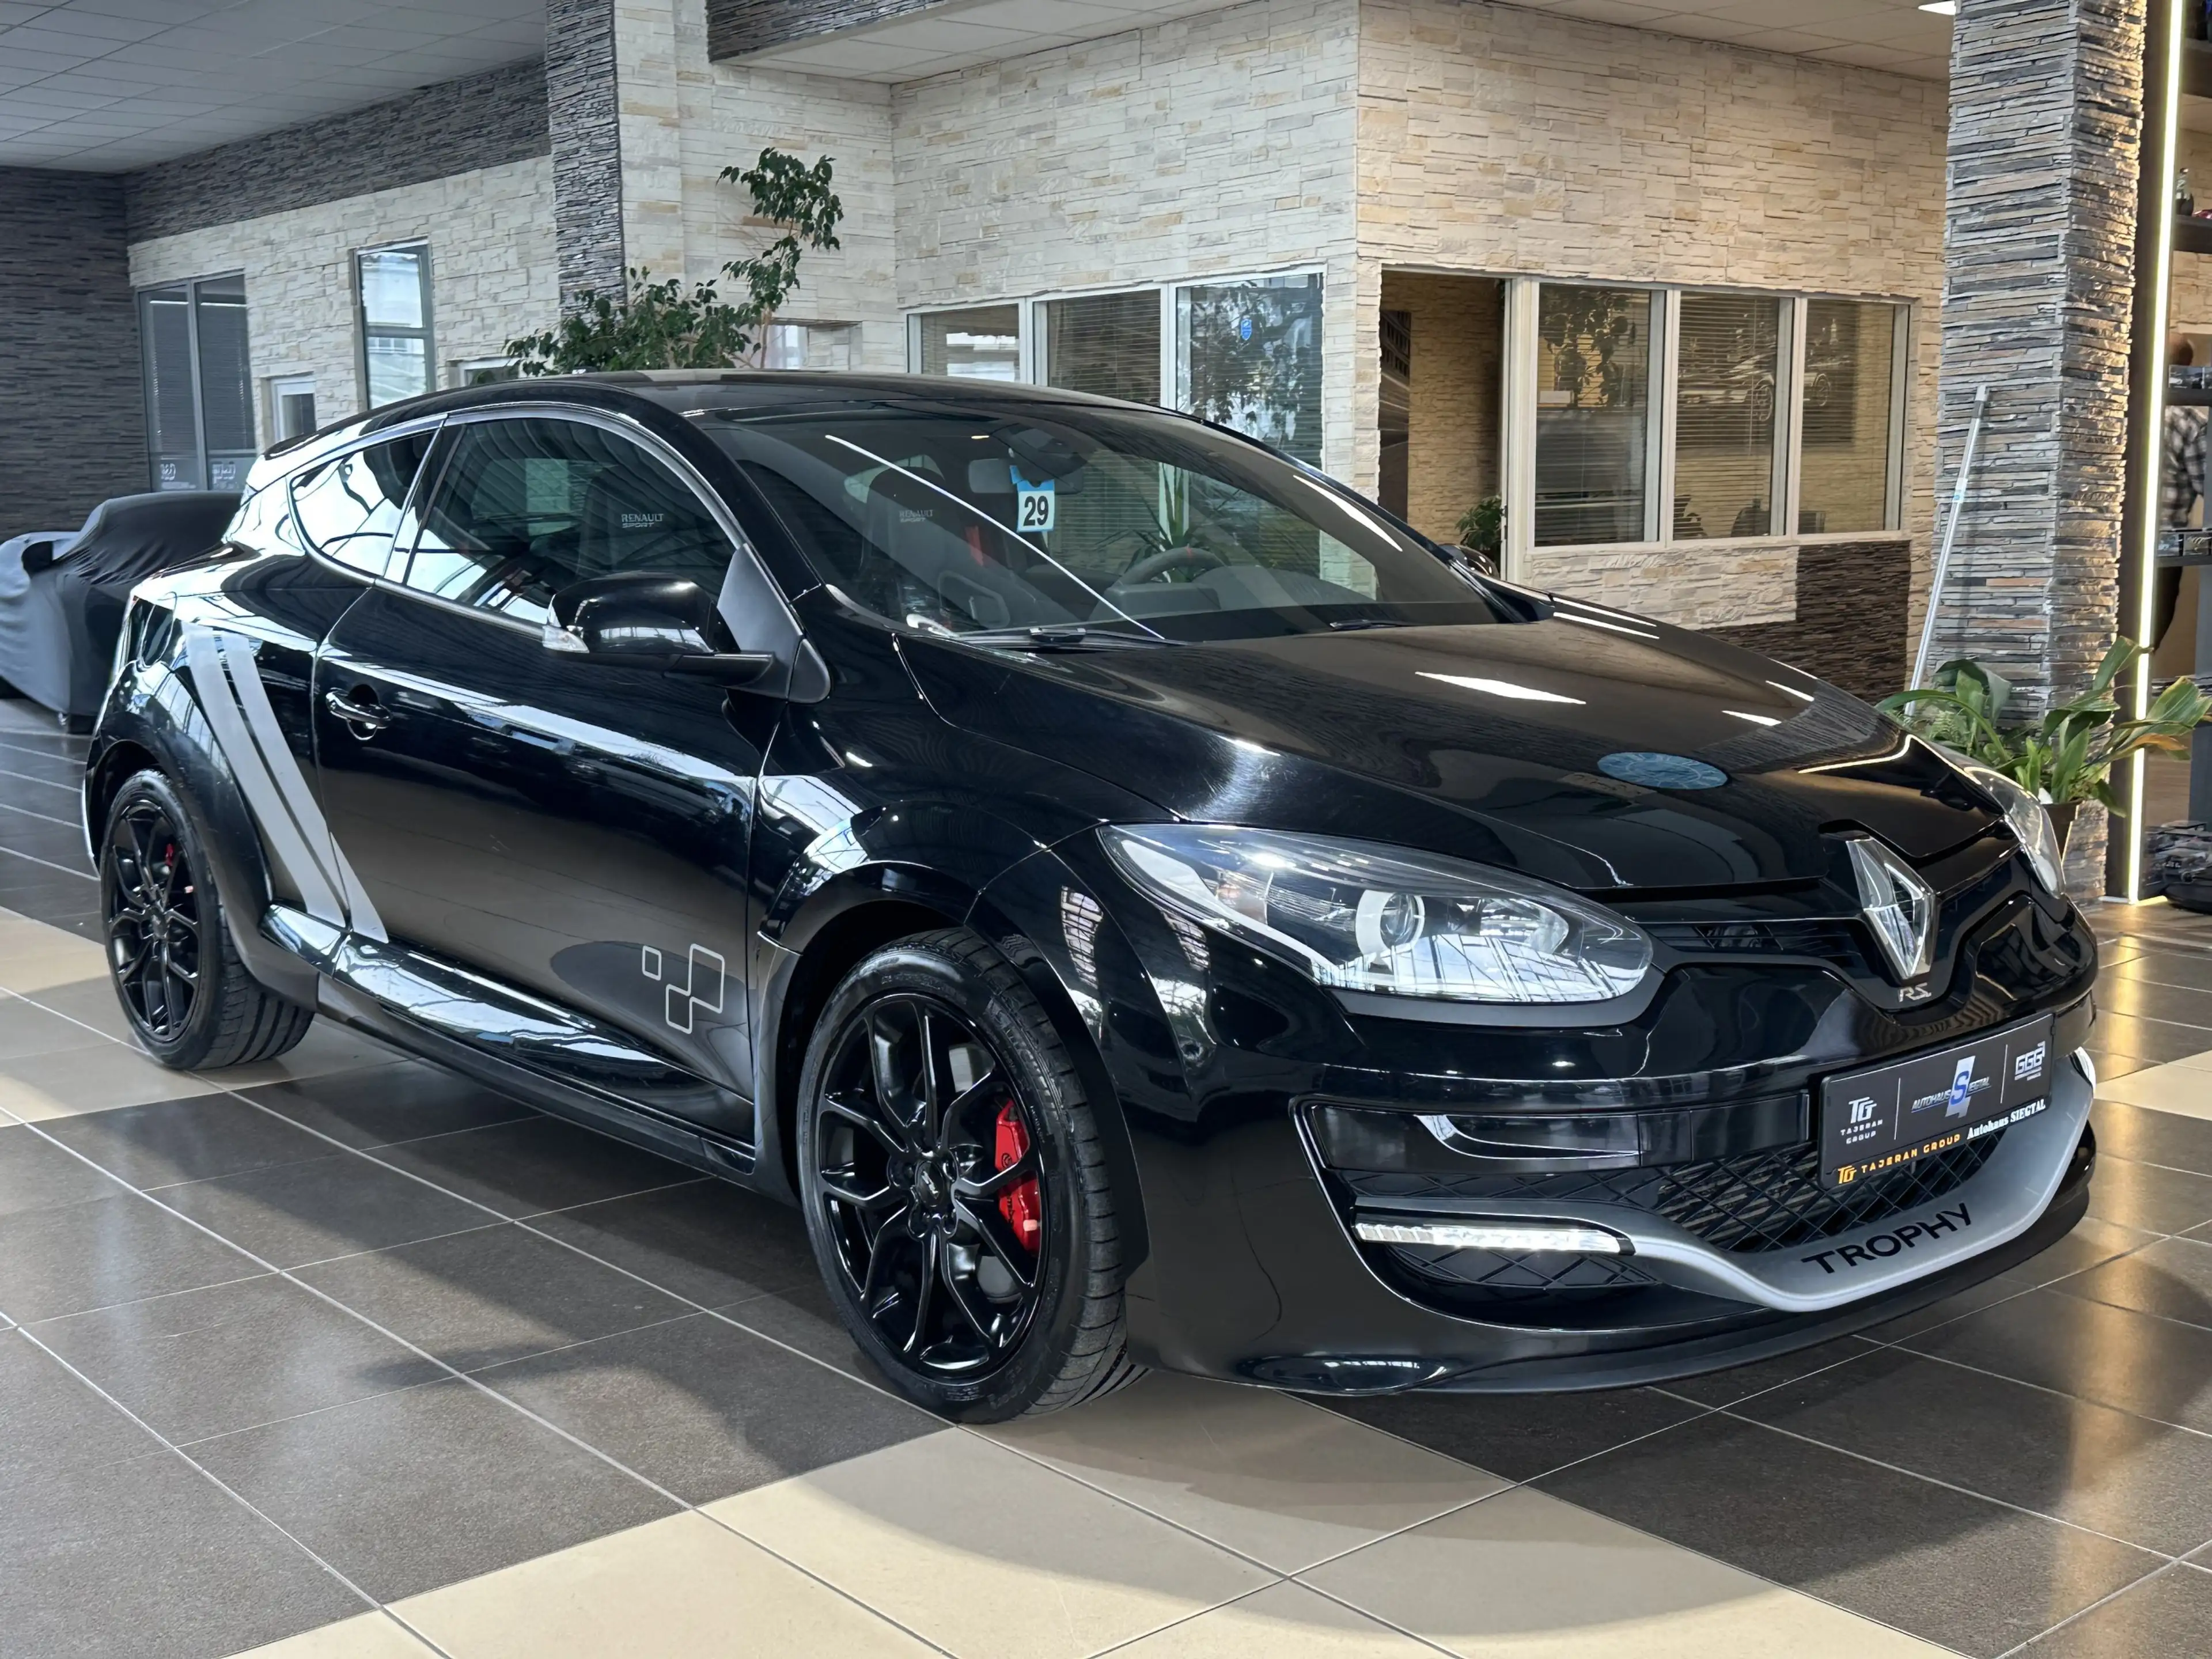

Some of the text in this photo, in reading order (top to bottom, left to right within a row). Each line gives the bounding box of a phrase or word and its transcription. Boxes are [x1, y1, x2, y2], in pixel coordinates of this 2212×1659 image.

[621, 513, 664, 522] RENAULT
[1022, 495, 1049, 527] 29
[1898, 982, 1932, 1002] RS
[1911, 1089, 1952, 1111] AUTOHAUS
[1840, 1119, 1883, 1136] TAJERAN
[1846, 1130, 1876, 1145] GROUP
[1861, 1149, 1918, 1174] TAJERAN
[1923, 1134, 1960, 1154] GROUP
[1967, 1116, 2009, 1140] Autohaus
[2010, 1099, 2046, 1123] SIEGTAL
[1801, 1202, 1973, 1274] TROPHY
